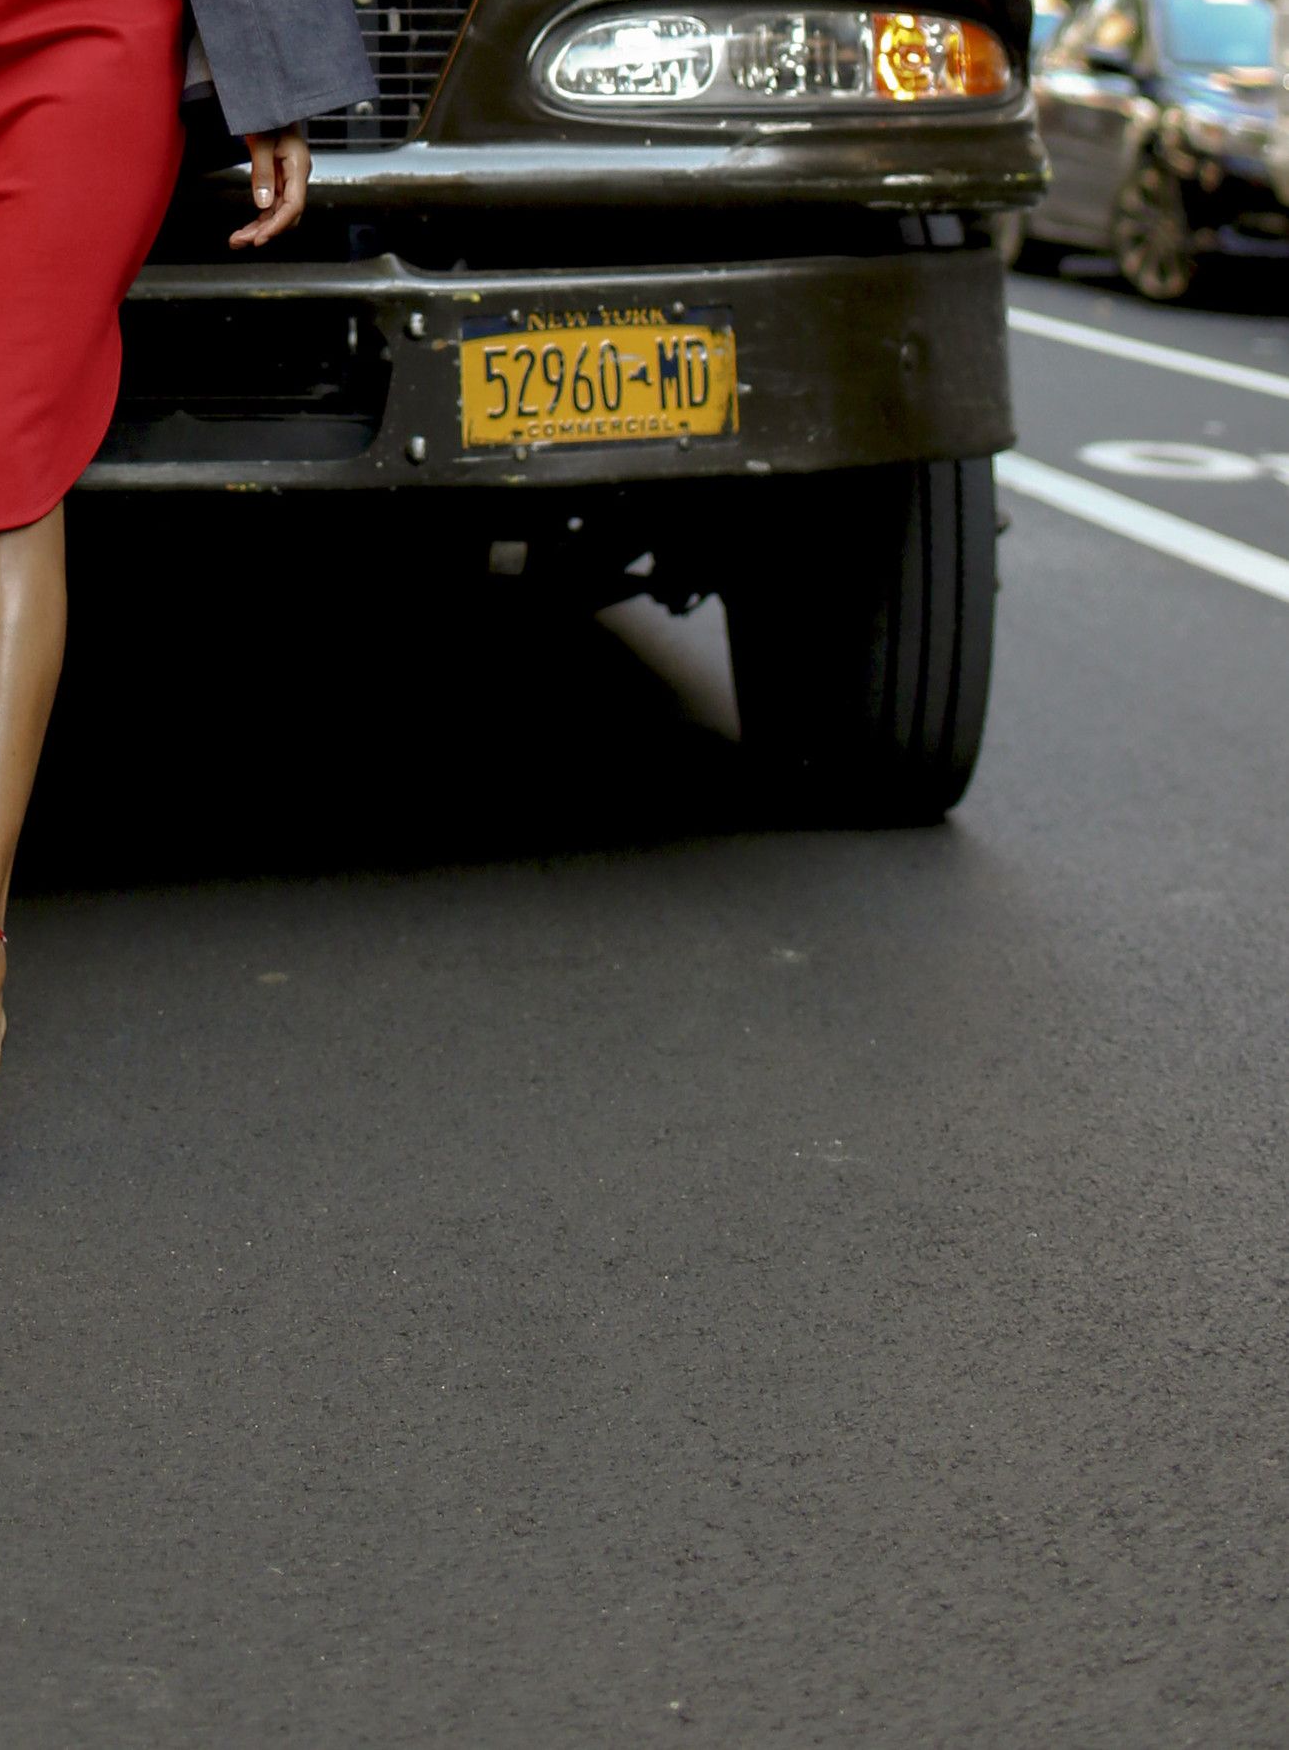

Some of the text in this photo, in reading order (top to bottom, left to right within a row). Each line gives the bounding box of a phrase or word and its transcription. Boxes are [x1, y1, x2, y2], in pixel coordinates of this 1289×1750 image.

[483, 334, 709, 419] 52960 MD
[526, 417, 675, 438] COMMERCIAL
